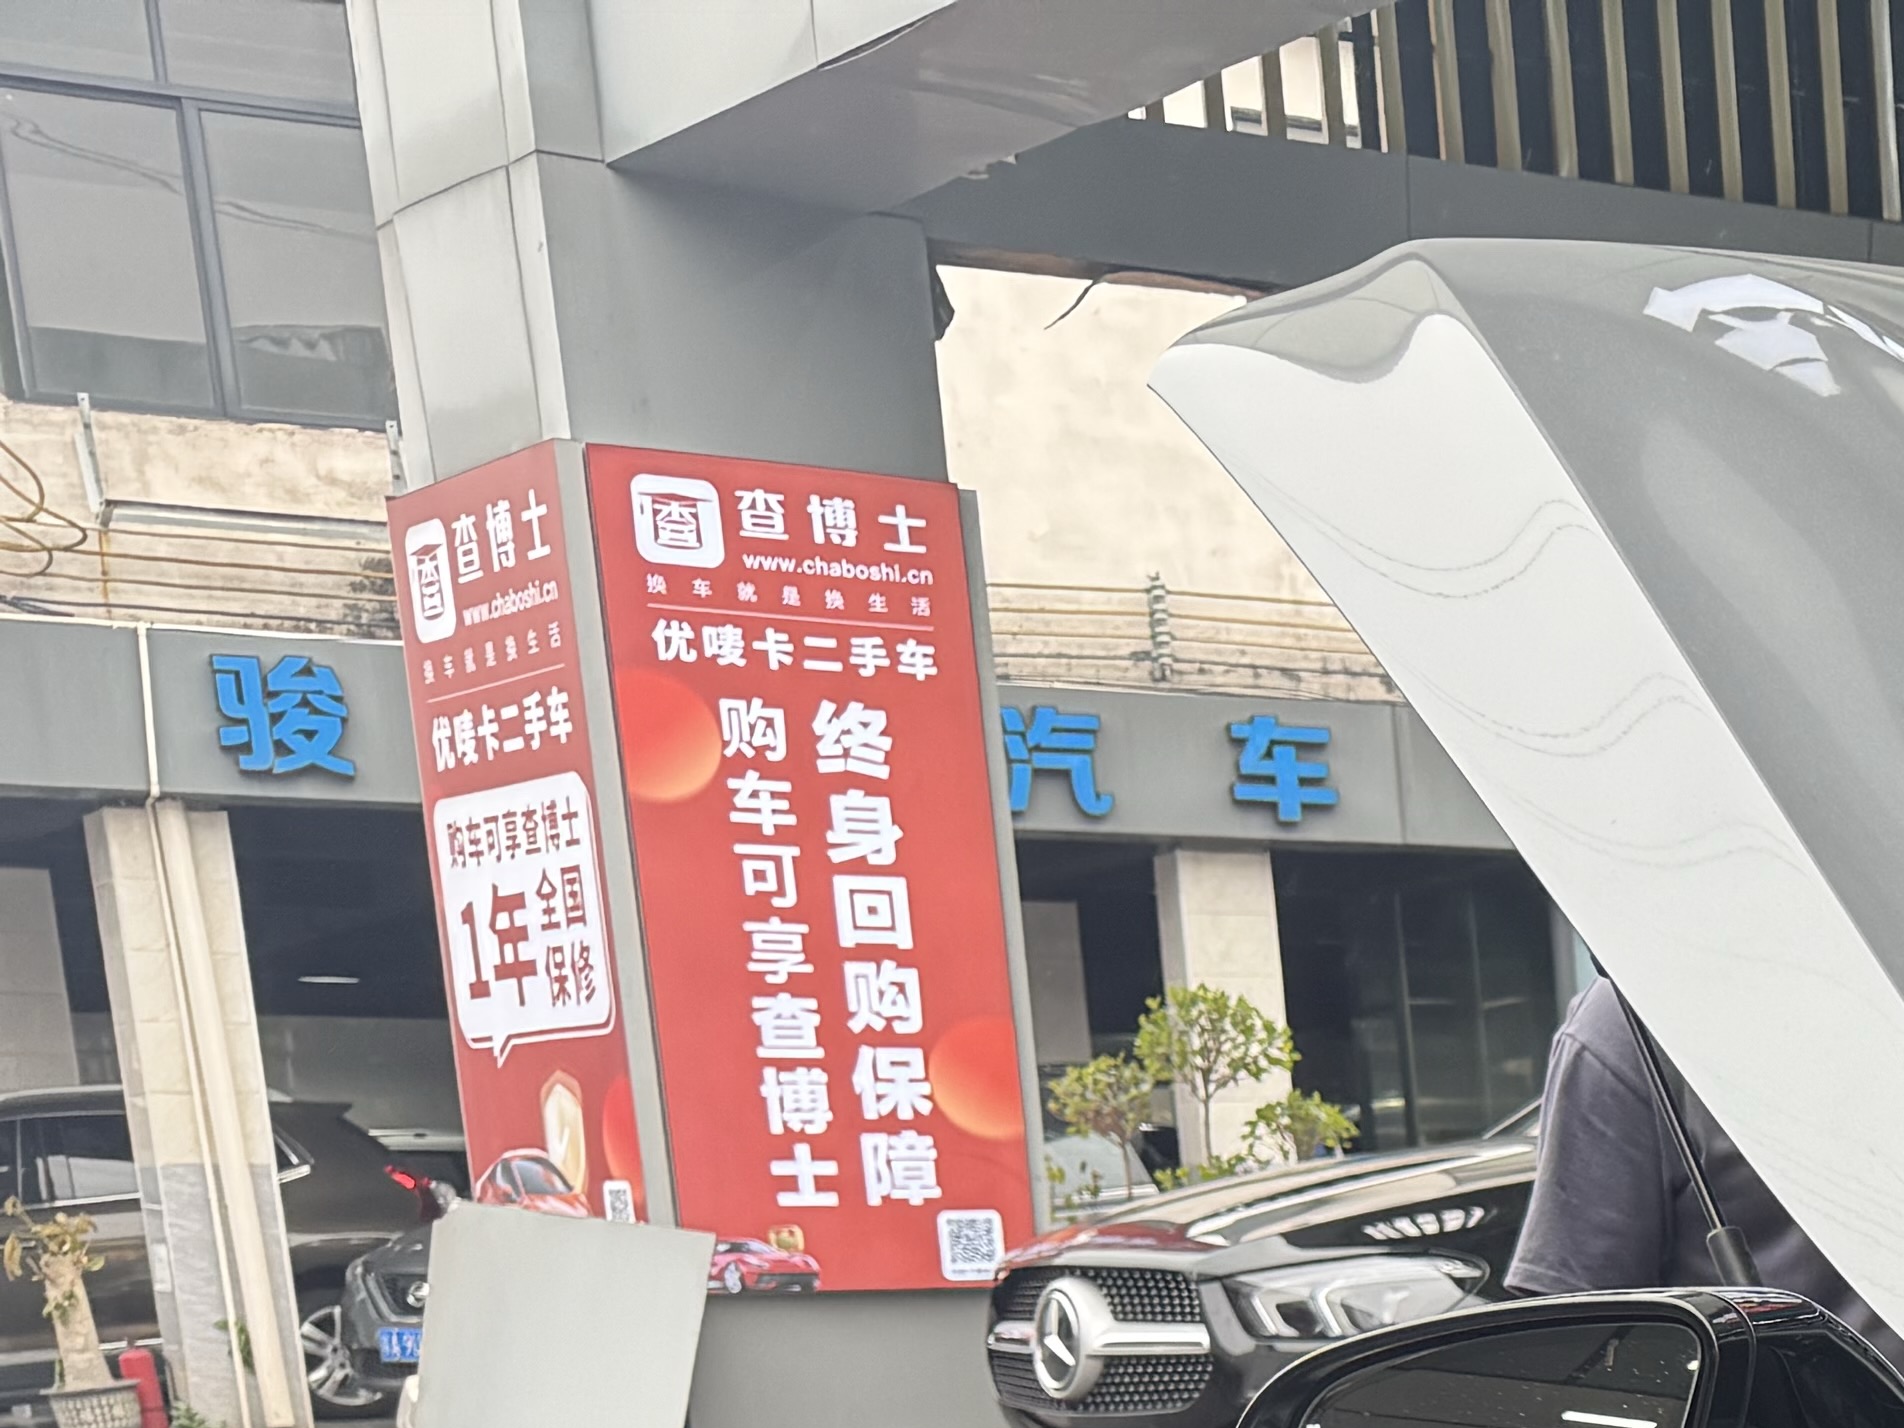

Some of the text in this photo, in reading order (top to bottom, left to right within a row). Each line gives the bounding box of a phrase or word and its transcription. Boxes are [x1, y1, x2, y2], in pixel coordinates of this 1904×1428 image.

[451, 488, 551, 584] 查博士
[734, 488, 927, 554] 查博士
[742, 553, 934, 585] www.chaboshi.cn
[651, 618, 938, 681] 优唛卡二手车
[211, 655, 355, 777] 骏
[432, 685, 573, 773] 优唛卡二手车
[447, 795, 581, 869] 购车可享查博士
[536, 864, 587, 931] 全国
[460, 883, 538, 1007] 1年
[545, 940, 596, 1007] 保修
[718, 697, 840, 1208] 购车可享查博士
[811, 699, 942, 1207] 终身回购保障
